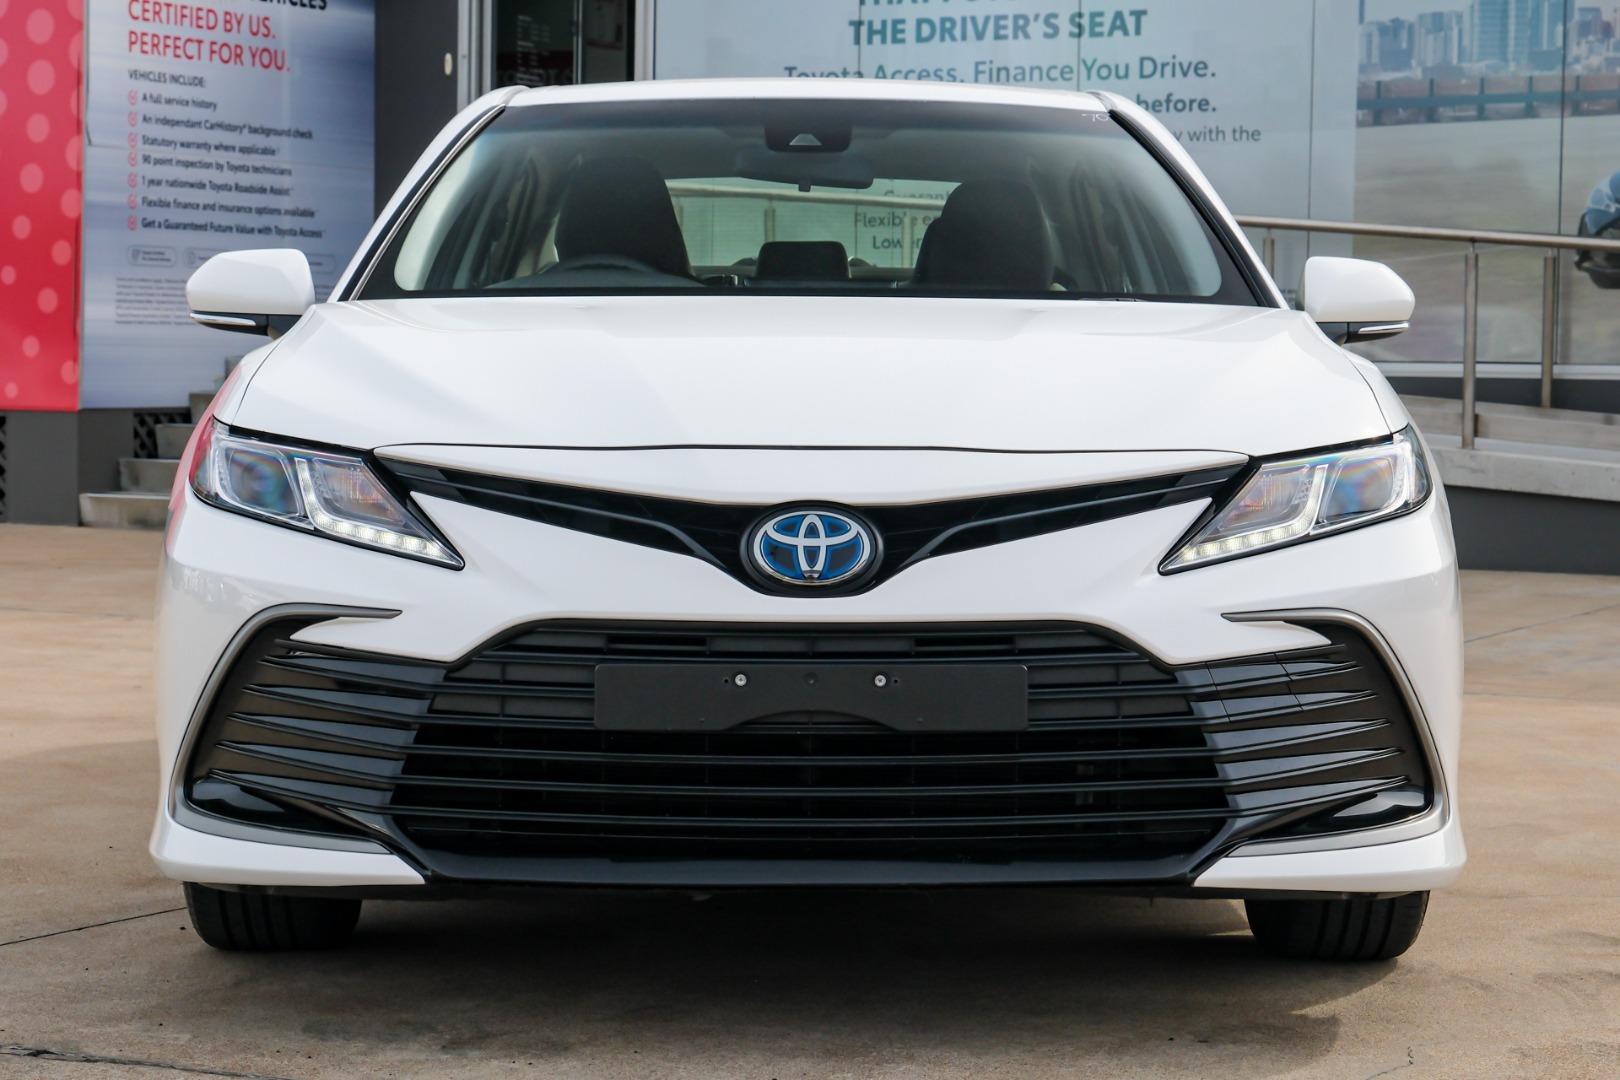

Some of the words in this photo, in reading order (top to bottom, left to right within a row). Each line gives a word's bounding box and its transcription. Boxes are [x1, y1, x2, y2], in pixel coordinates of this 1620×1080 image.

[128, 0, 218, 31] CERTIFIED
[223, 11, 244, 33] BY
[249, 16, 276, 39] US.
[848, 18, 906, 46] THE
[915, 13, 1060, 44] DRIVER'S
[1068, 9, 1148, 38] SEAT
[128, 31, 204, 61] PERFECT
[209, 42, 244, 66] FOR
[249, 47, 291, 72] YOU.
[128, 69, 167, 83] VEHICLES
[169, 74, 206, 88] INCLUDE:
[973, 59, 1074, 83] Finance
[1081, 58, 1130, 81] You
[1139, 55, 1217, 79] Drive.
[142, 92, 147, 101] A
[149, 93, 162, 104] full
[164, 96, 189, 107] service
[191, 98, 217, 112] history
[142, 114, 152, 122] An
[248, 123, 291, 138] background
[292, 127, 313, 139] check
[1187, 126, 1227, 142] with
[1232, 125, 1262, 142] the
[142, 134, 177, 151] Statutory
[179, 141, 211, 153] warranty
[213, 142, 236, 153] where
[142, 154, 151, 164] 90
[153, 157, 173, 167] point
[175, 158, 213, 170] inspection
[215, 160, 224, 171] by
[226, 161, 250, 174] Toyota
[147, 178, 162, 188] year
[165, 178, 207, 190] nationwide
[208, 180, 232, 193] Toyota
[235, 182, 267, 194] Roadside
[142, 196, 171, 208] Flexible
[173, 198, 200, 210] finance
[202, 202, 216, 211] and
[218, 203, 253, 214] insurance
[141, 217, 156, 228] Get
[163, 219, 208, 231] Guaranteed
[210, 221, 233, 232] Future
[235, 223, 255, 234] Value
[257, 225, 273, 235] with
[274, 225, 298, 238] Toyota
